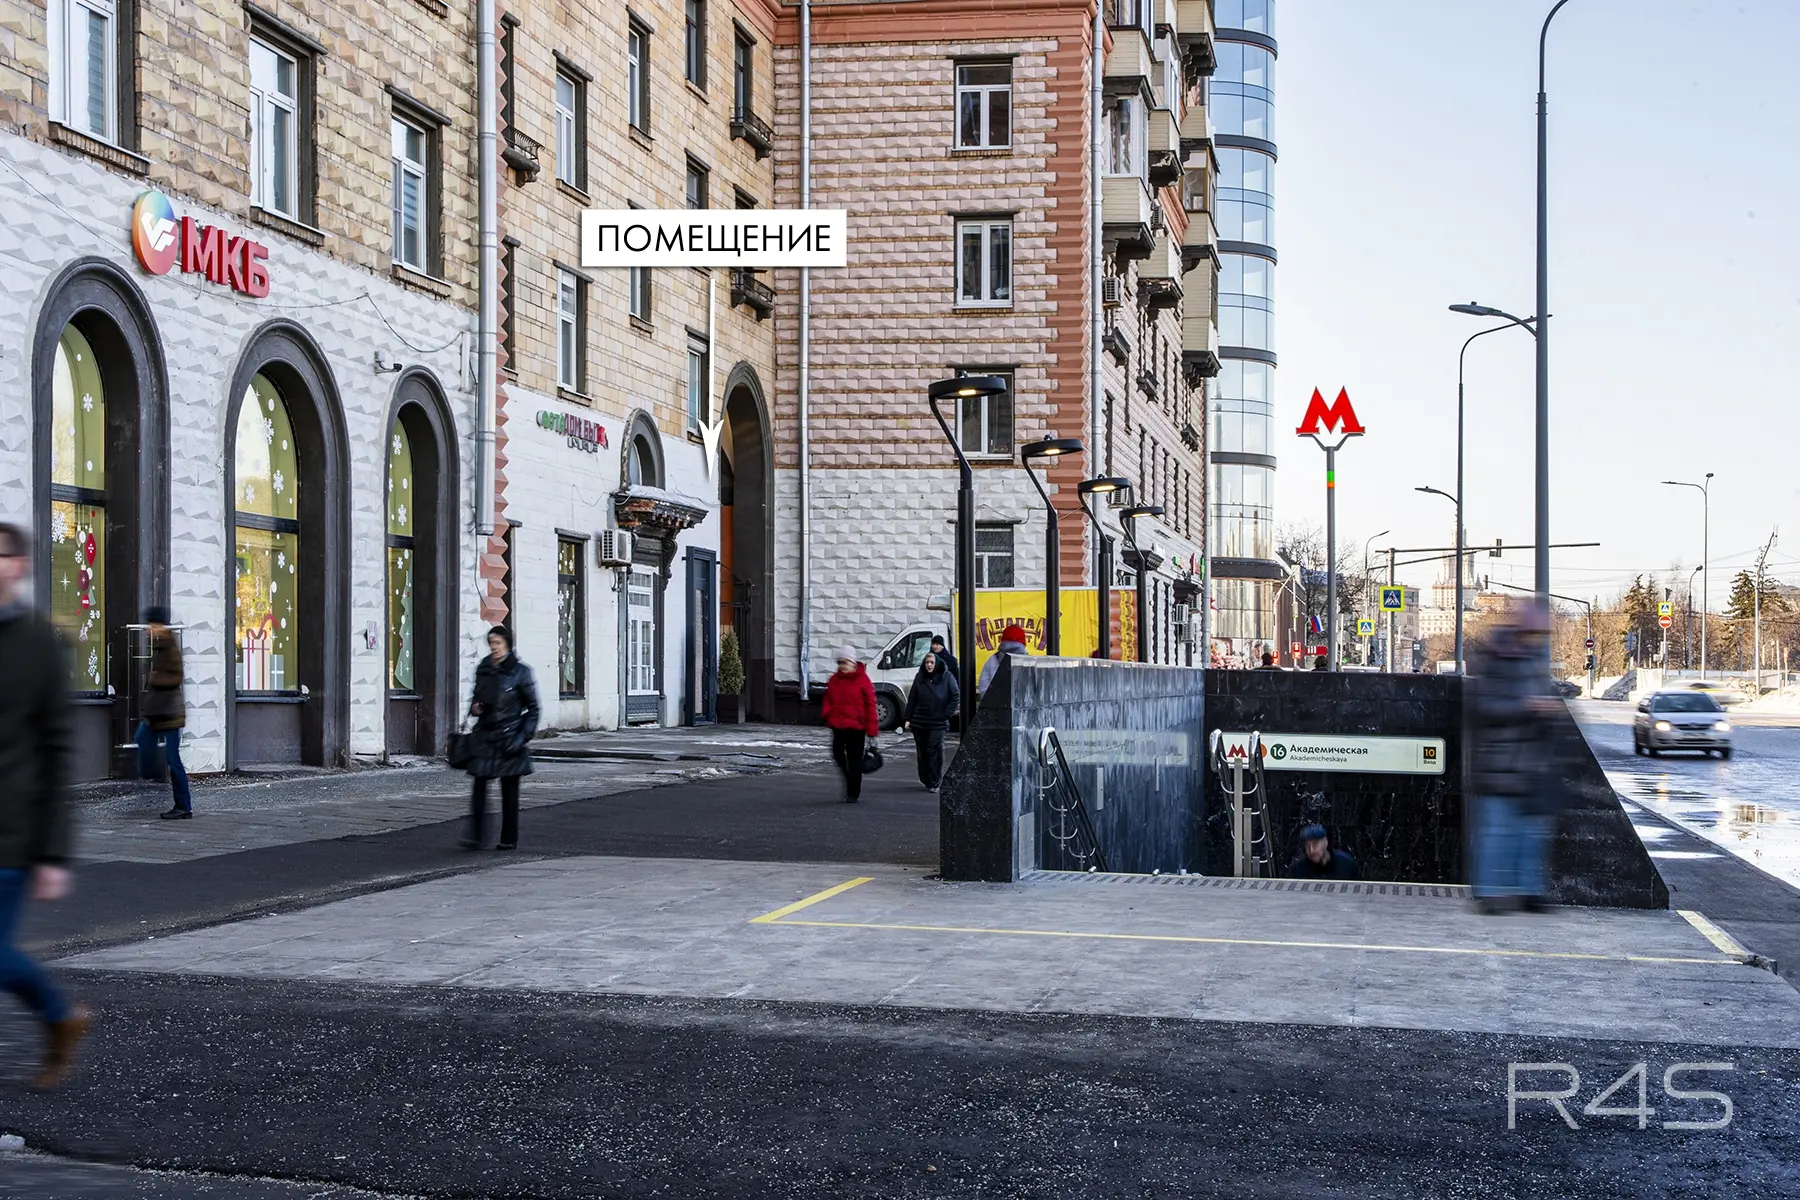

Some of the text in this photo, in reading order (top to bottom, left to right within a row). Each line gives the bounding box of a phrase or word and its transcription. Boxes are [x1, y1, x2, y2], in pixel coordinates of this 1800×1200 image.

[181, 216, 270, 298] МКБ
[1272, 744, 1368, 757] 16 Академическая
[1425, 748, 1435, 758] 10
[1290, 755, 1347, 763] Akademicheskaya
